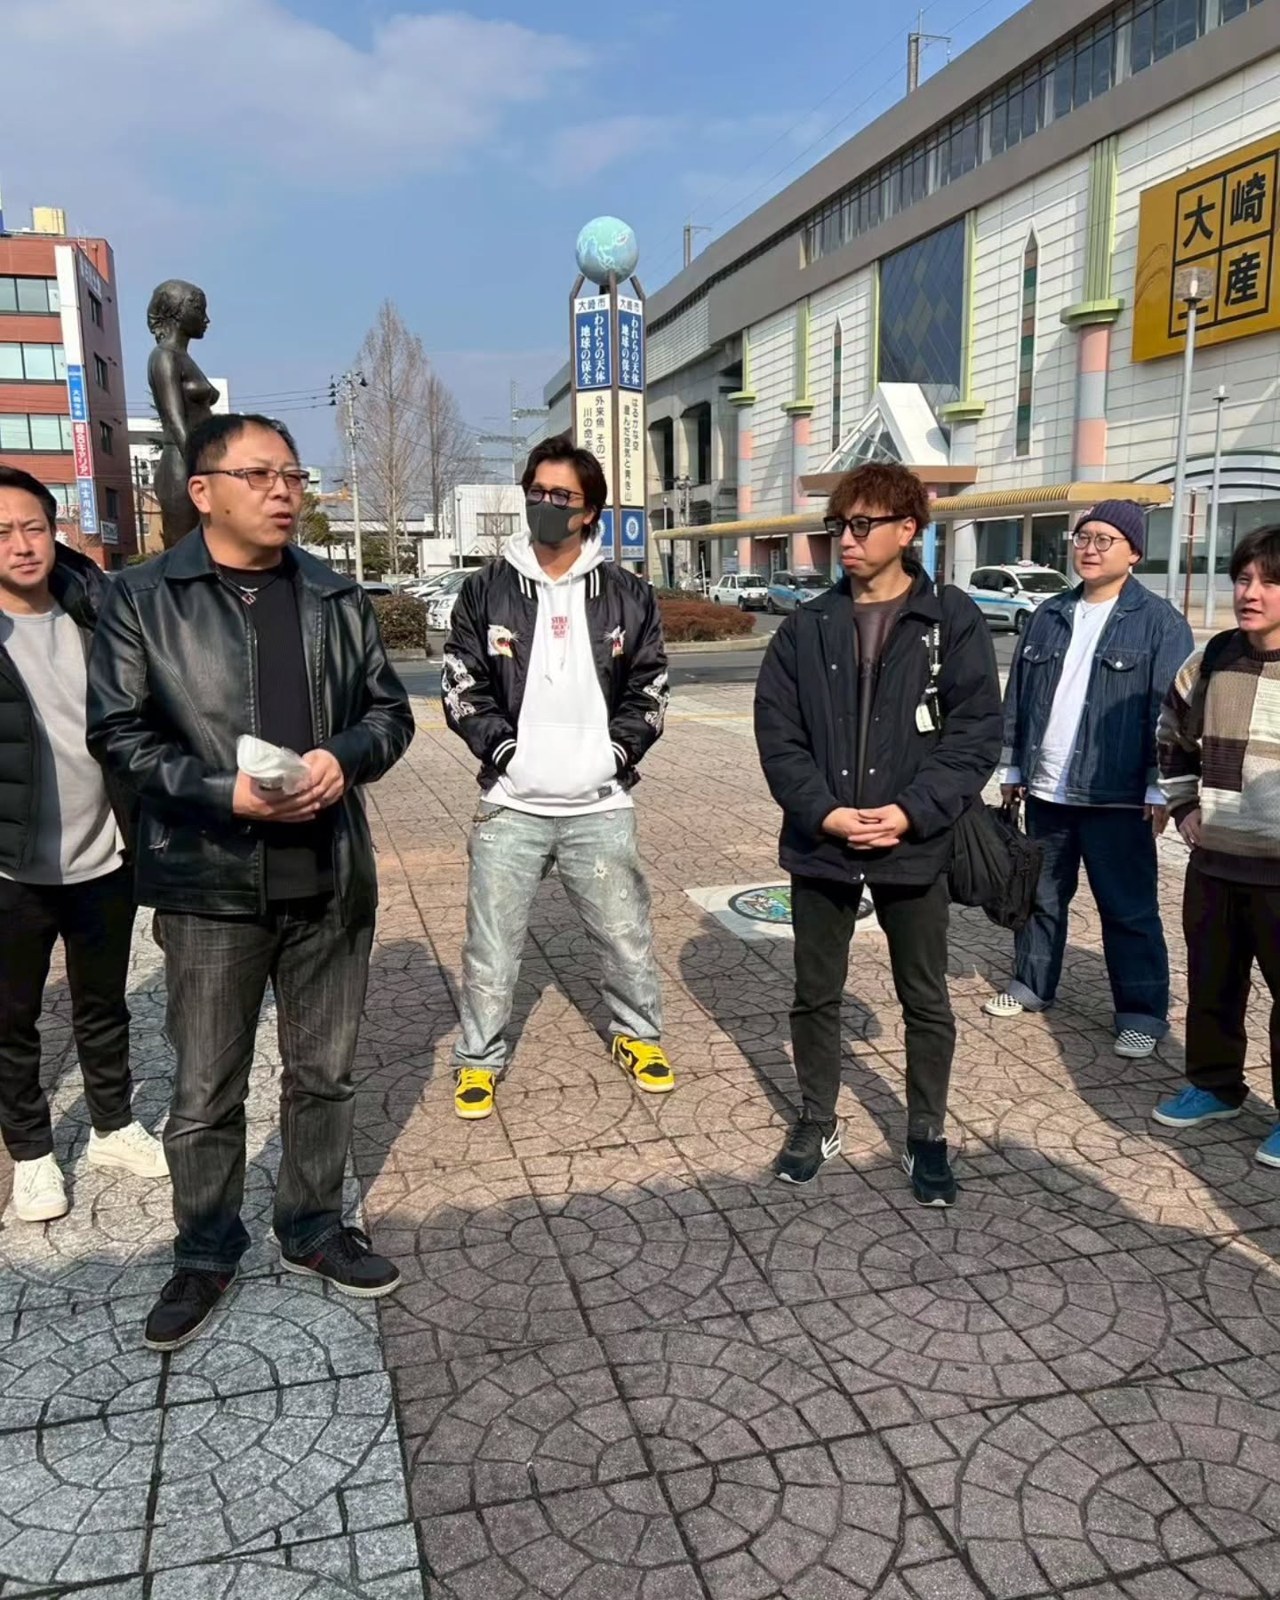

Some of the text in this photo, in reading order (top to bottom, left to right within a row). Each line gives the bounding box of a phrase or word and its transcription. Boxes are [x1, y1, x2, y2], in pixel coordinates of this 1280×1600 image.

[1182, 171, 1266, 249] 大崎
[578, 298, 606, 312] 大崎市
[620, 299, 639, 312] 大崎市
[581, 325, 592, 384] 地球の保全
[594, 313, 606, 383] われらの天体
[621, 324, 630, 384] 地球の保全
[631, 316, 640, 385] われらの天体
[595, 395, 605, 428] 外来魚
